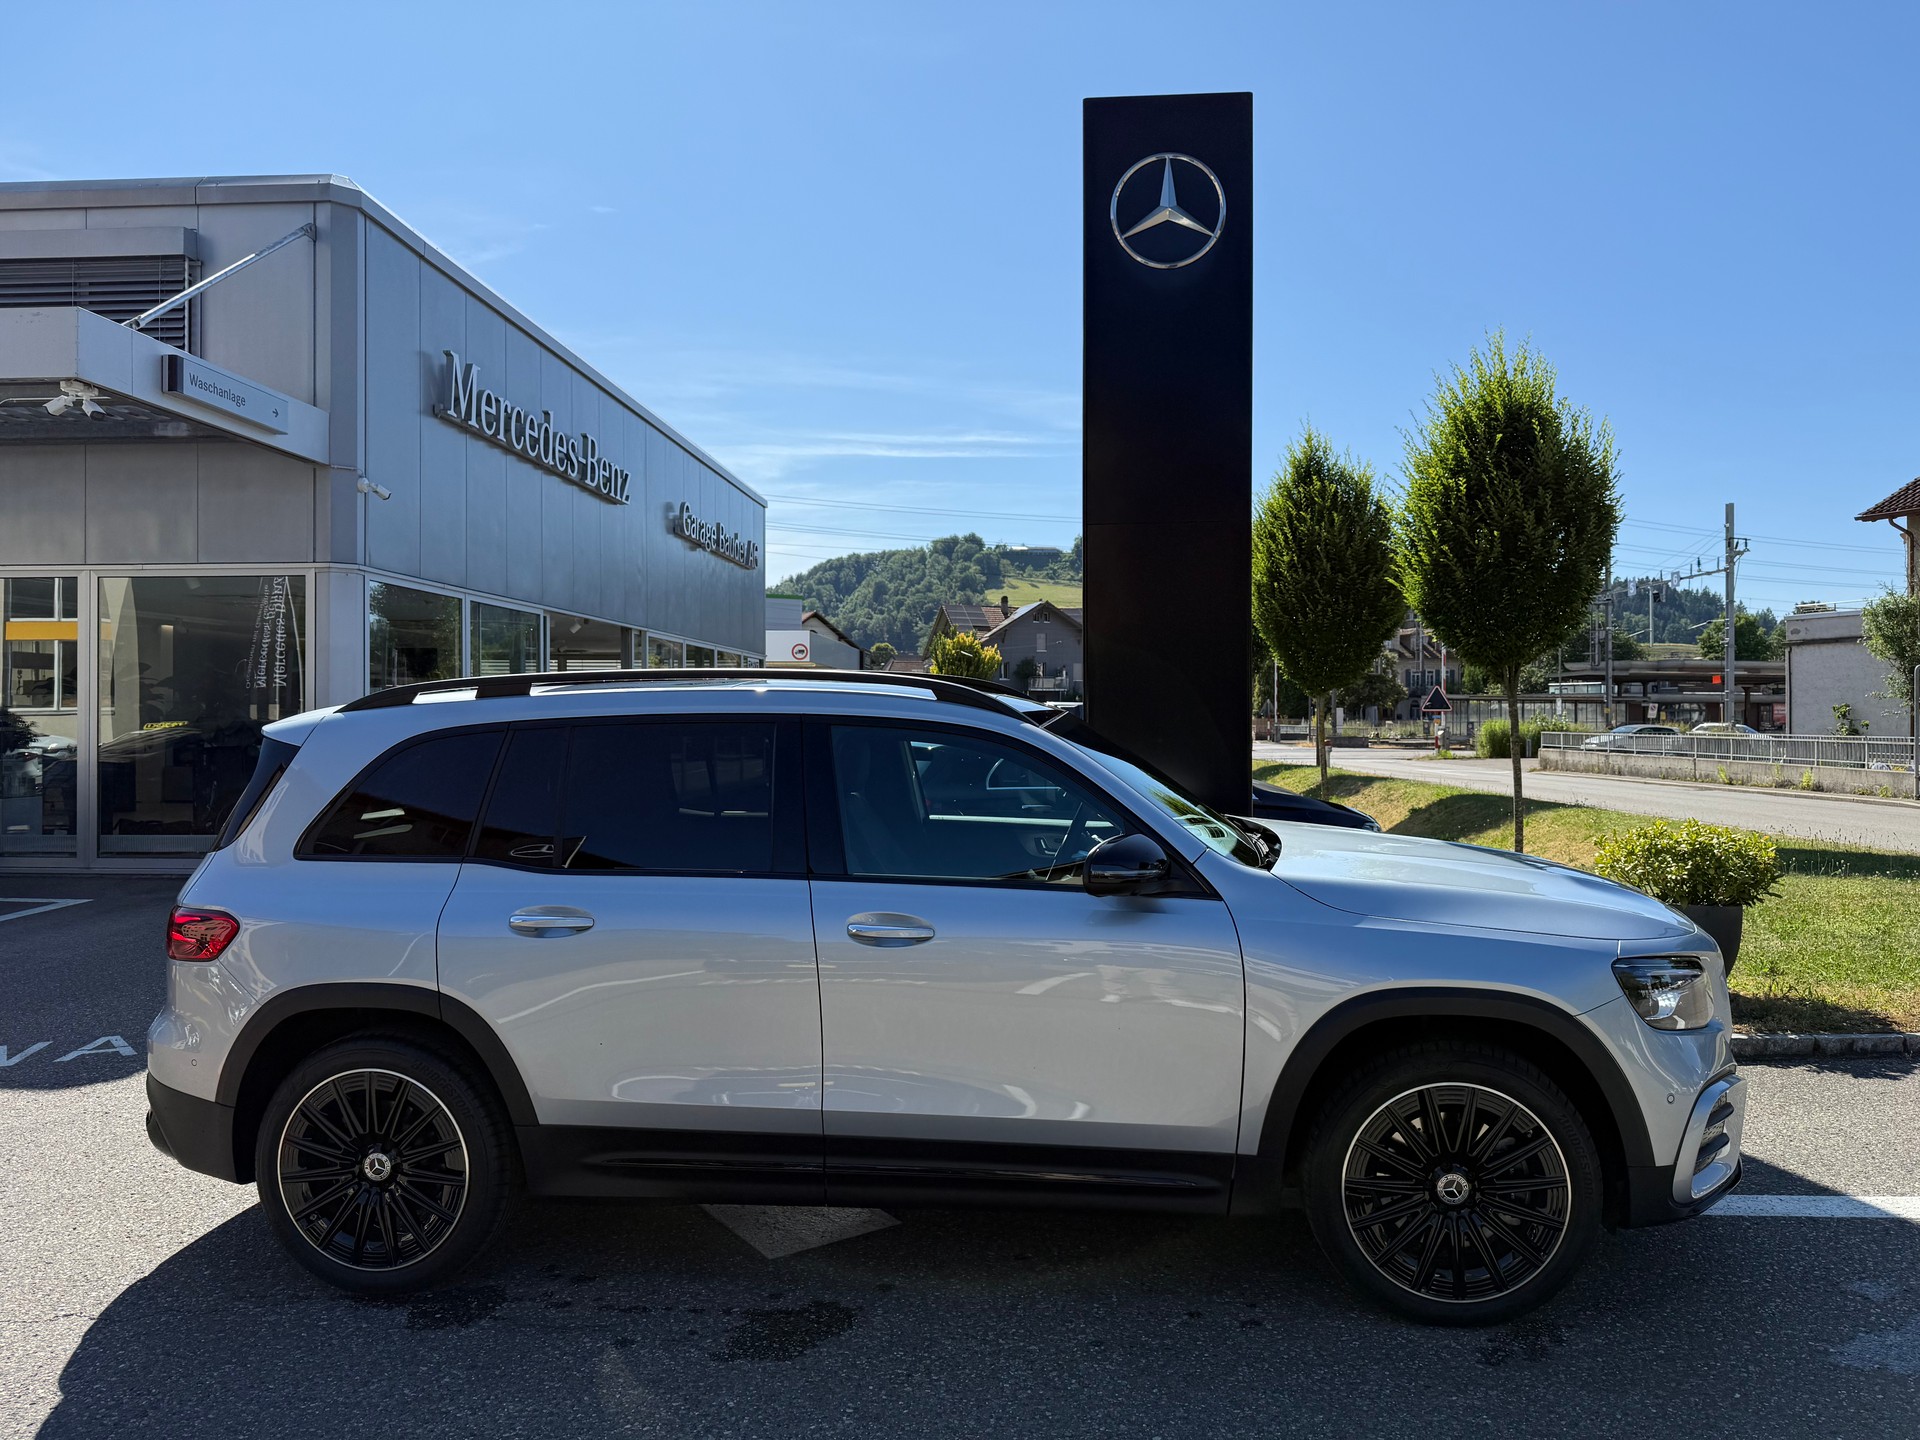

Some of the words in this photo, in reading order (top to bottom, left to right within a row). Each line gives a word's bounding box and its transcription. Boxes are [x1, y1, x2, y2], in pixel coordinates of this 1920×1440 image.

[189, 373, 246, 407] Waschanlage
[443, 350, 632, 505] Mercedes-Benz
[680, 502, 717, 552] Garage
[748, 540, 759, 569] AG
